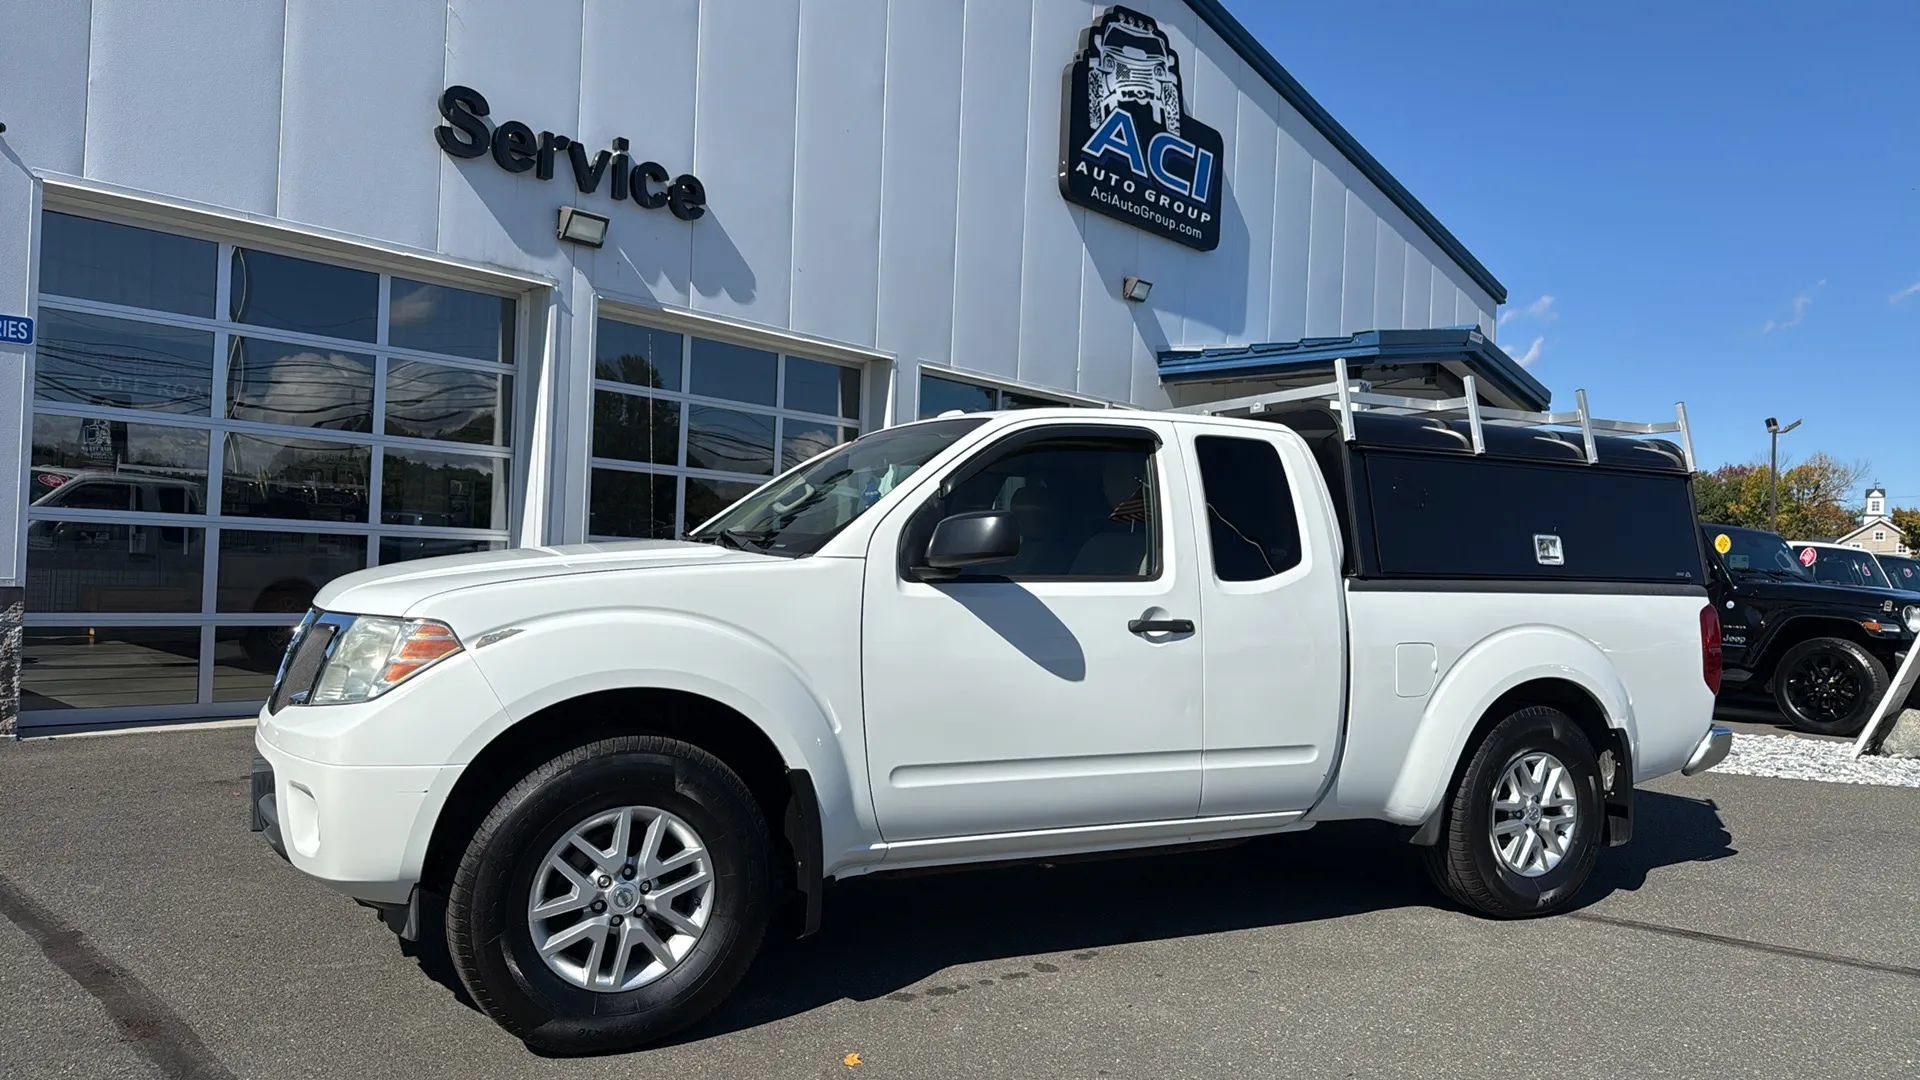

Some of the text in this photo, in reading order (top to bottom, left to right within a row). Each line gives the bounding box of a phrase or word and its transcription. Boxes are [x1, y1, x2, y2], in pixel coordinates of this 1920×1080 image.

[434, 85, 706, 221] Service
[1081, 107, 1214, 204] ACI
[1076, 161, 1211, 223] AUTO GROUP
[1090, 186, 1202, 239] AciAutoGroup.com
[1722, 633, 1747, 645] Jeep
